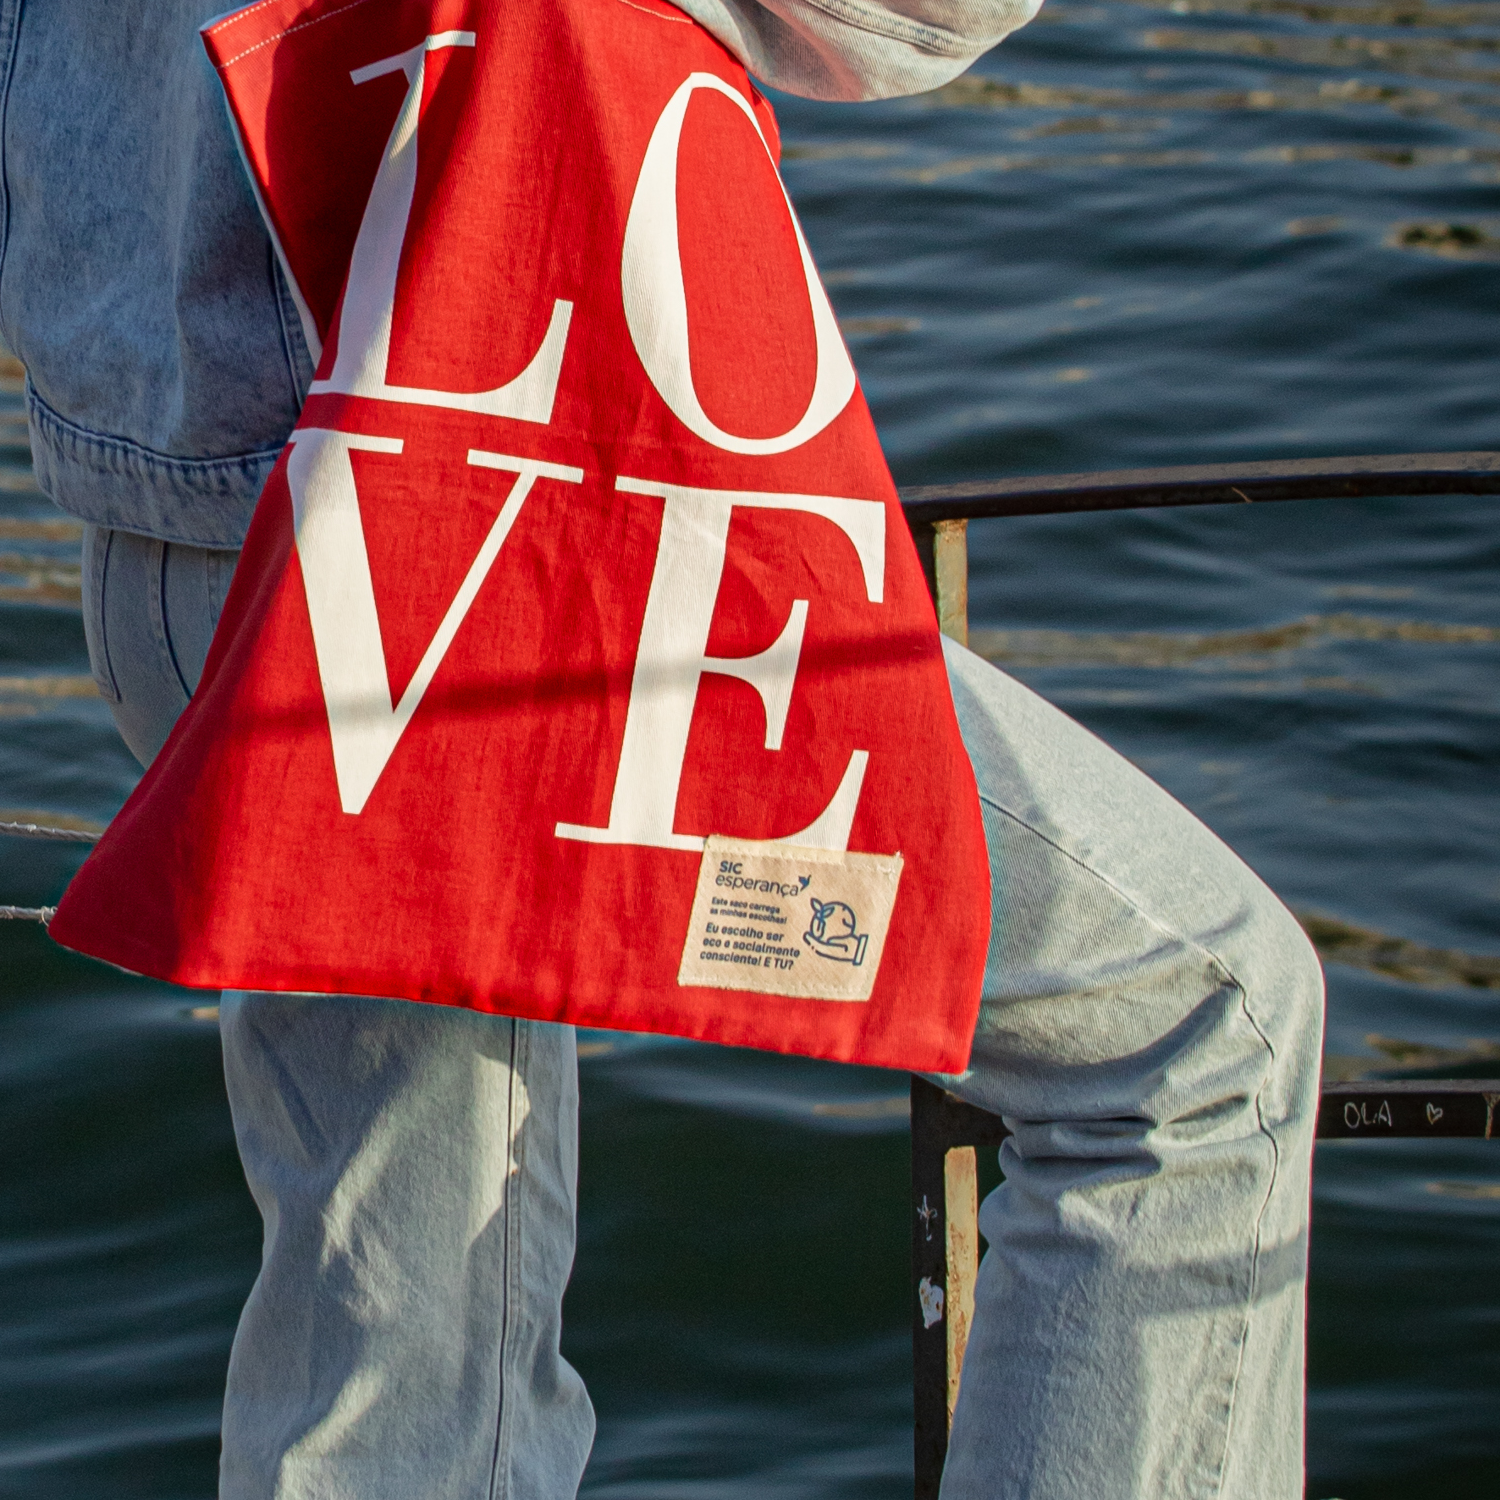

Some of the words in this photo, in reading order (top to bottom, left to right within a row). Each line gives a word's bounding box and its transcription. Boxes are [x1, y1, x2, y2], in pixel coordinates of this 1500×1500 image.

[308, 28, 858, 457] LO
[288, 426, 887, 853] VE
[719, 860, 743, 875] SIC
[715, 874, 799, 898] esperança
[711, 896, 728, 906] Este
[729, 900, 748, 909] saco
[749, 902, 781, 914] carrega
[720, 908, 747, 918] minhas
[749, 912, 787, 924] escolhas!
[705, 922, 719, 933] Eu
[721, 926, 763, 939] escolho
[766, 932, 785, 942] ser
[703, 938, 722, 947] eco
[724, 940, 730, 948] e
[732, 941, 800, 958] socialmente
[700, 950, 761, 966] consciente!
[763, 957, 772, 967] E
[774, 957, 794, 970] TU?
